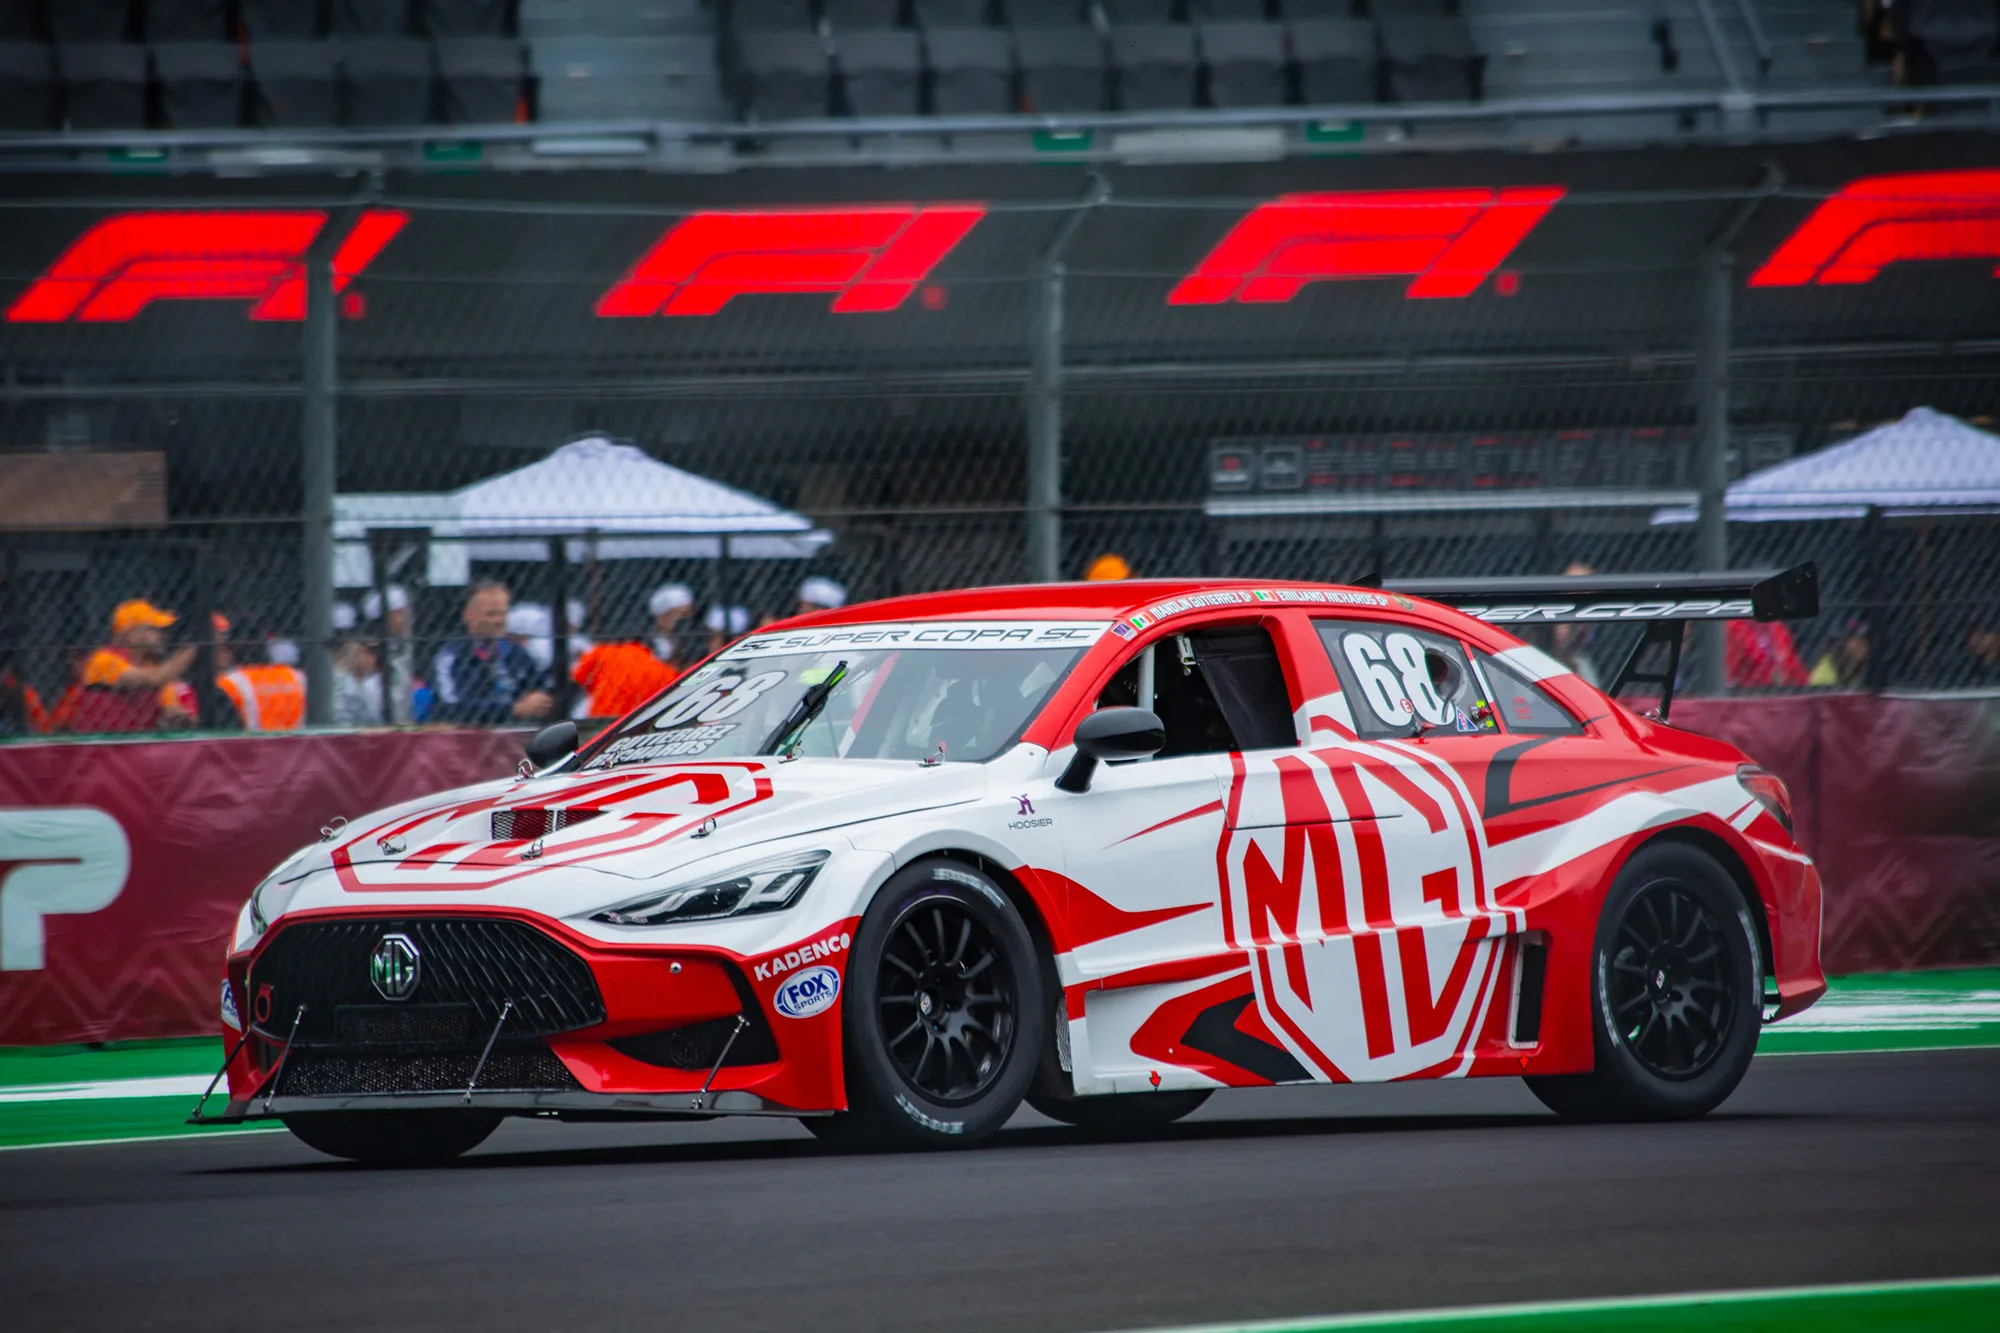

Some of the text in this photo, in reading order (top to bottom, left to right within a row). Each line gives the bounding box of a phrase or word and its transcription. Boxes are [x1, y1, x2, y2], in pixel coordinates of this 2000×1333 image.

[1167, 186, 1567, 305] F1
[1748, 168, 2000, 287] F
[4, 210, 409, 322] F1
[594, 203, 986, 316] F1
[1149, 598, 1192, 620] MANOLIN
[1188, 592, 1242, 608] GUTIERREZ
[1276, 591, 1326, 603] EMILIANO
[1324, 592, 1377, 606] RICHARDS
[1575, 600, 1753, 618] COPA
[780, 630, 910, 648] SUPER
[913, 628, 1034, 642] COPA
[1037, 627, 1101, 641] SC
[654, 670, 788, 729] 68
[1343, 632, 1456, 726] 68
[604, 723, 739, 754] GUTIERREZ
[1008, 818, 1053, 830] HOOSIER
[1243, 746, 1490, 1060] MG
[373, 938, 414, 996] MG
[753, 932, 850, 982] KADENCO
[786, 973, 829, 1005] FOX
[794, 989, 833, 1012] SPORTS
